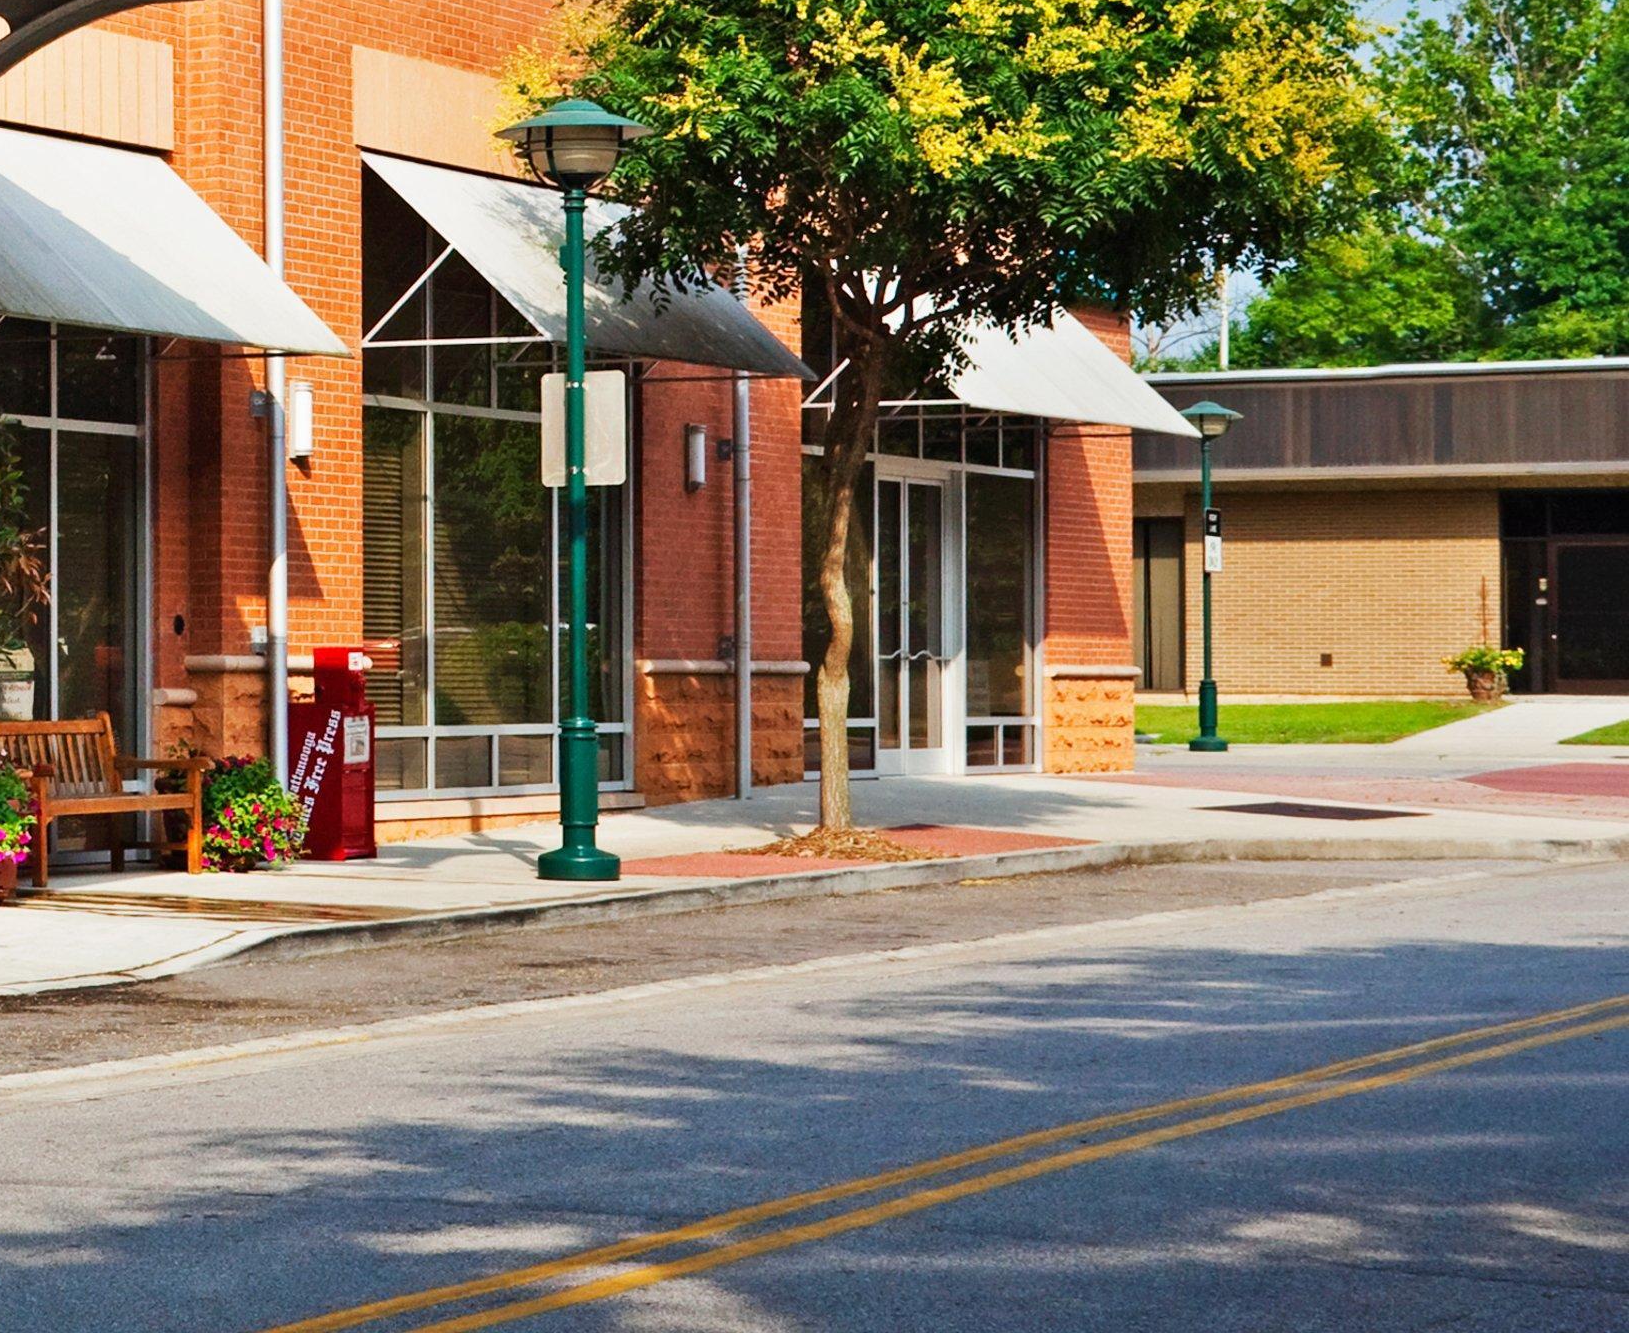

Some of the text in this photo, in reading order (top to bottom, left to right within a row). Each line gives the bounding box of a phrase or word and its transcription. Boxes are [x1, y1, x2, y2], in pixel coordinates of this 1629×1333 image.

[289, 731, 317, 794] attanooga
[303, 757, 327, 795] Free
[315, 709, 342, 755] Press
